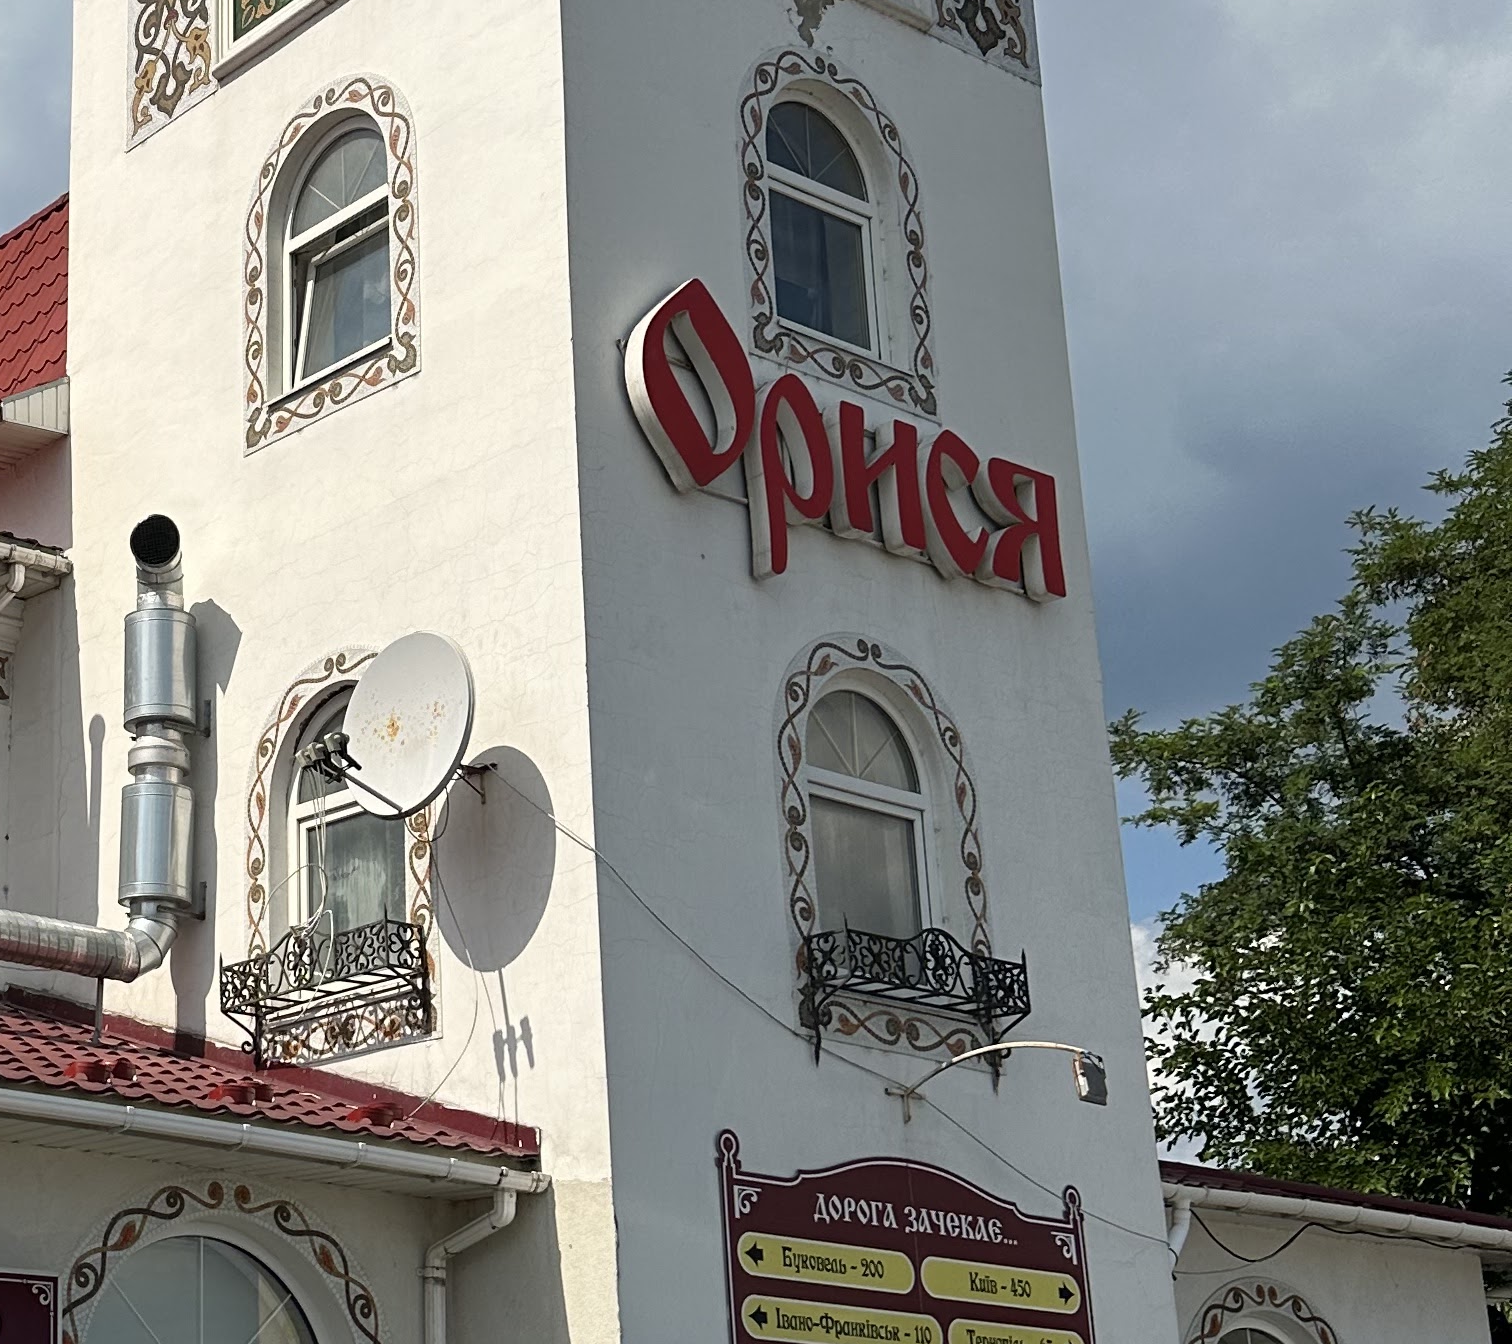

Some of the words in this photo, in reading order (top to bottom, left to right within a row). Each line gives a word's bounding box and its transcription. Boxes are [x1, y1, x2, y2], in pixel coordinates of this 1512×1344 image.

[626, 278, 1067, 600] Орися
[813, 1192, 899, 1230] ДОРОГА
[781, 1245, 847, 1275] Буковель
[860, 1258, 885, 1279] 200
[969, 1271, 998, 1295] Київ
[1010, 1277, 1032, 1298] 450
[775, 1306, 900, 1341] Івано-Франківськ
[914, 1325, 933, 1344] 110
